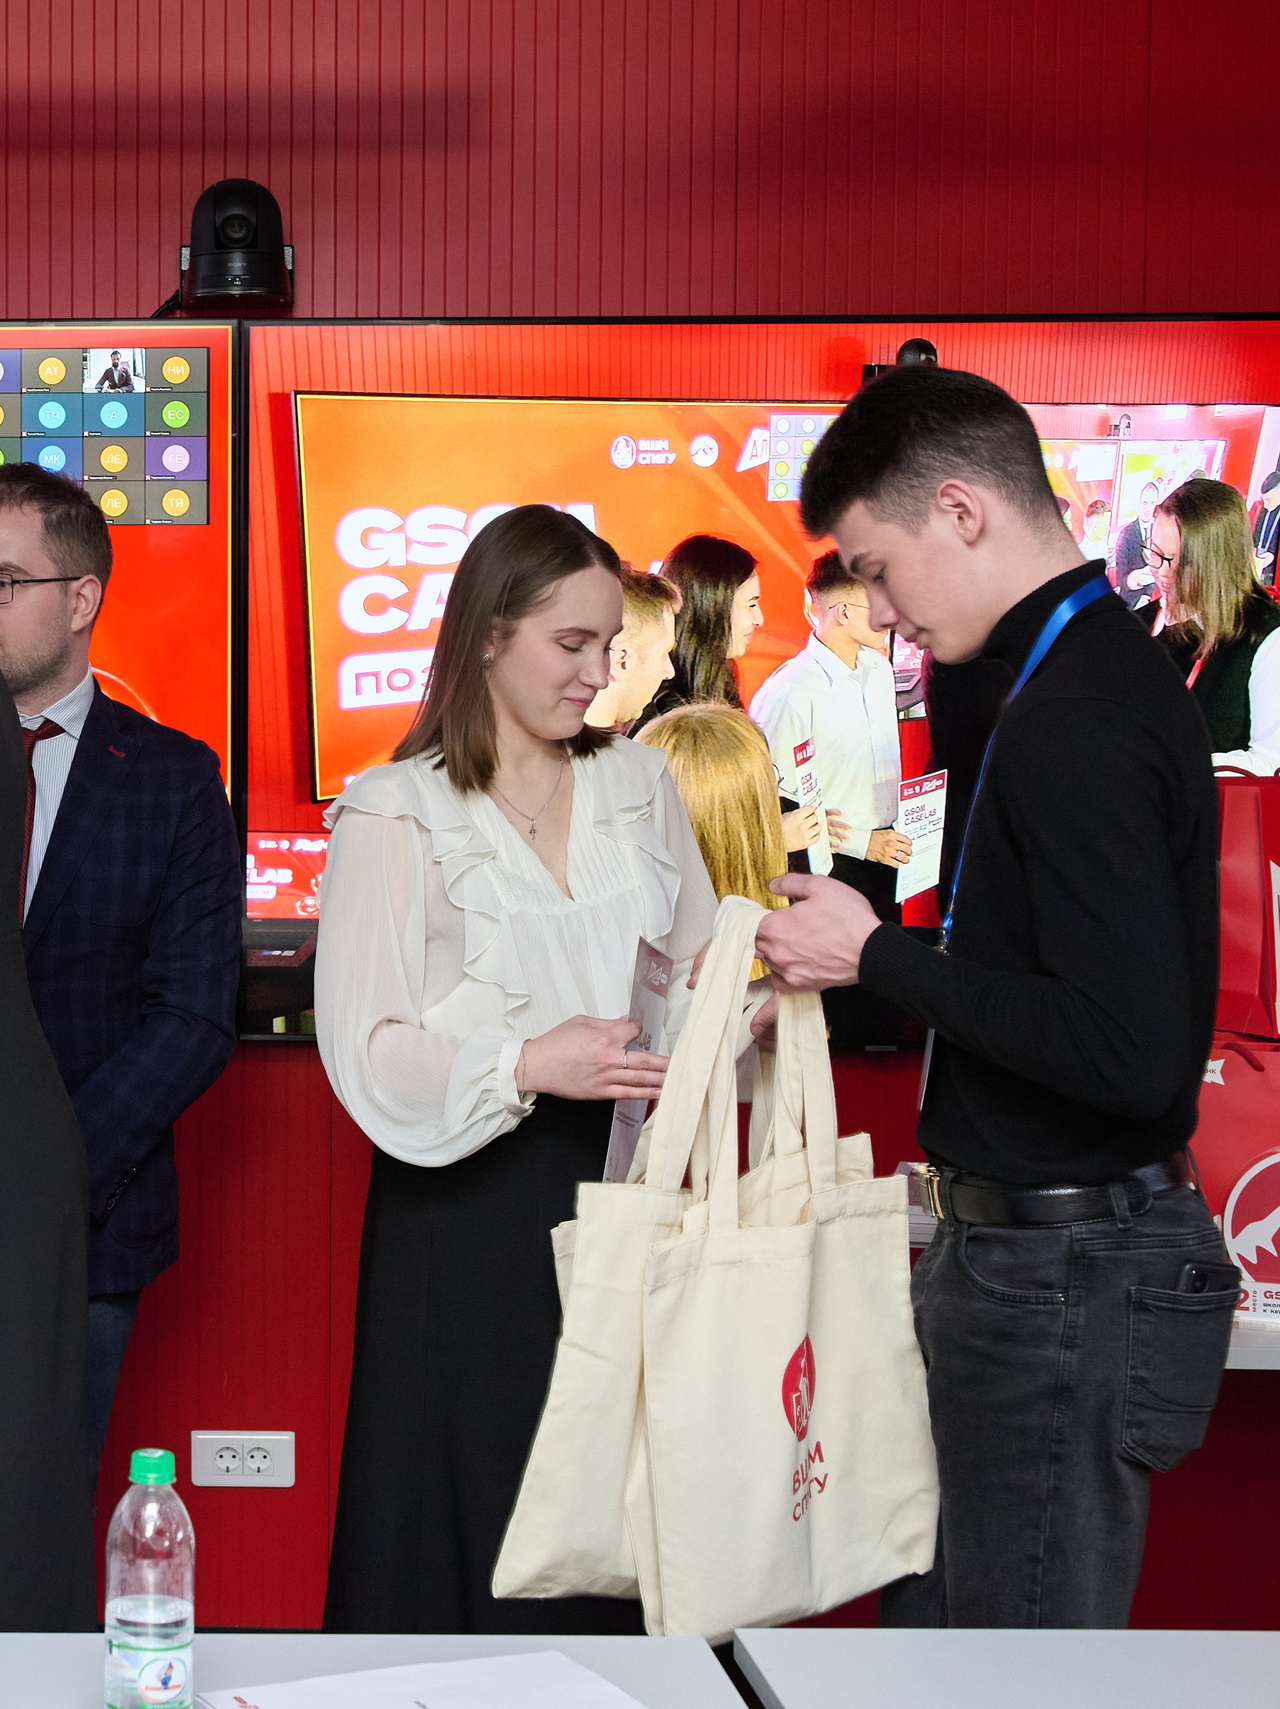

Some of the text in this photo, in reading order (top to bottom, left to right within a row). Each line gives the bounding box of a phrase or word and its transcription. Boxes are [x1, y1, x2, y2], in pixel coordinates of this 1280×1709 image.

[44, 366, 60, 376] АТ
[167, 366, 185, 375] НИ
[168, 410, 185, 420] ЕС
[44, 454, 61, 464] МК
[106, 454, 122, 464] ЛЕ
[106, 498, 122, 508] ЛЕ
[168, 498, 184, 508] ТЯ
